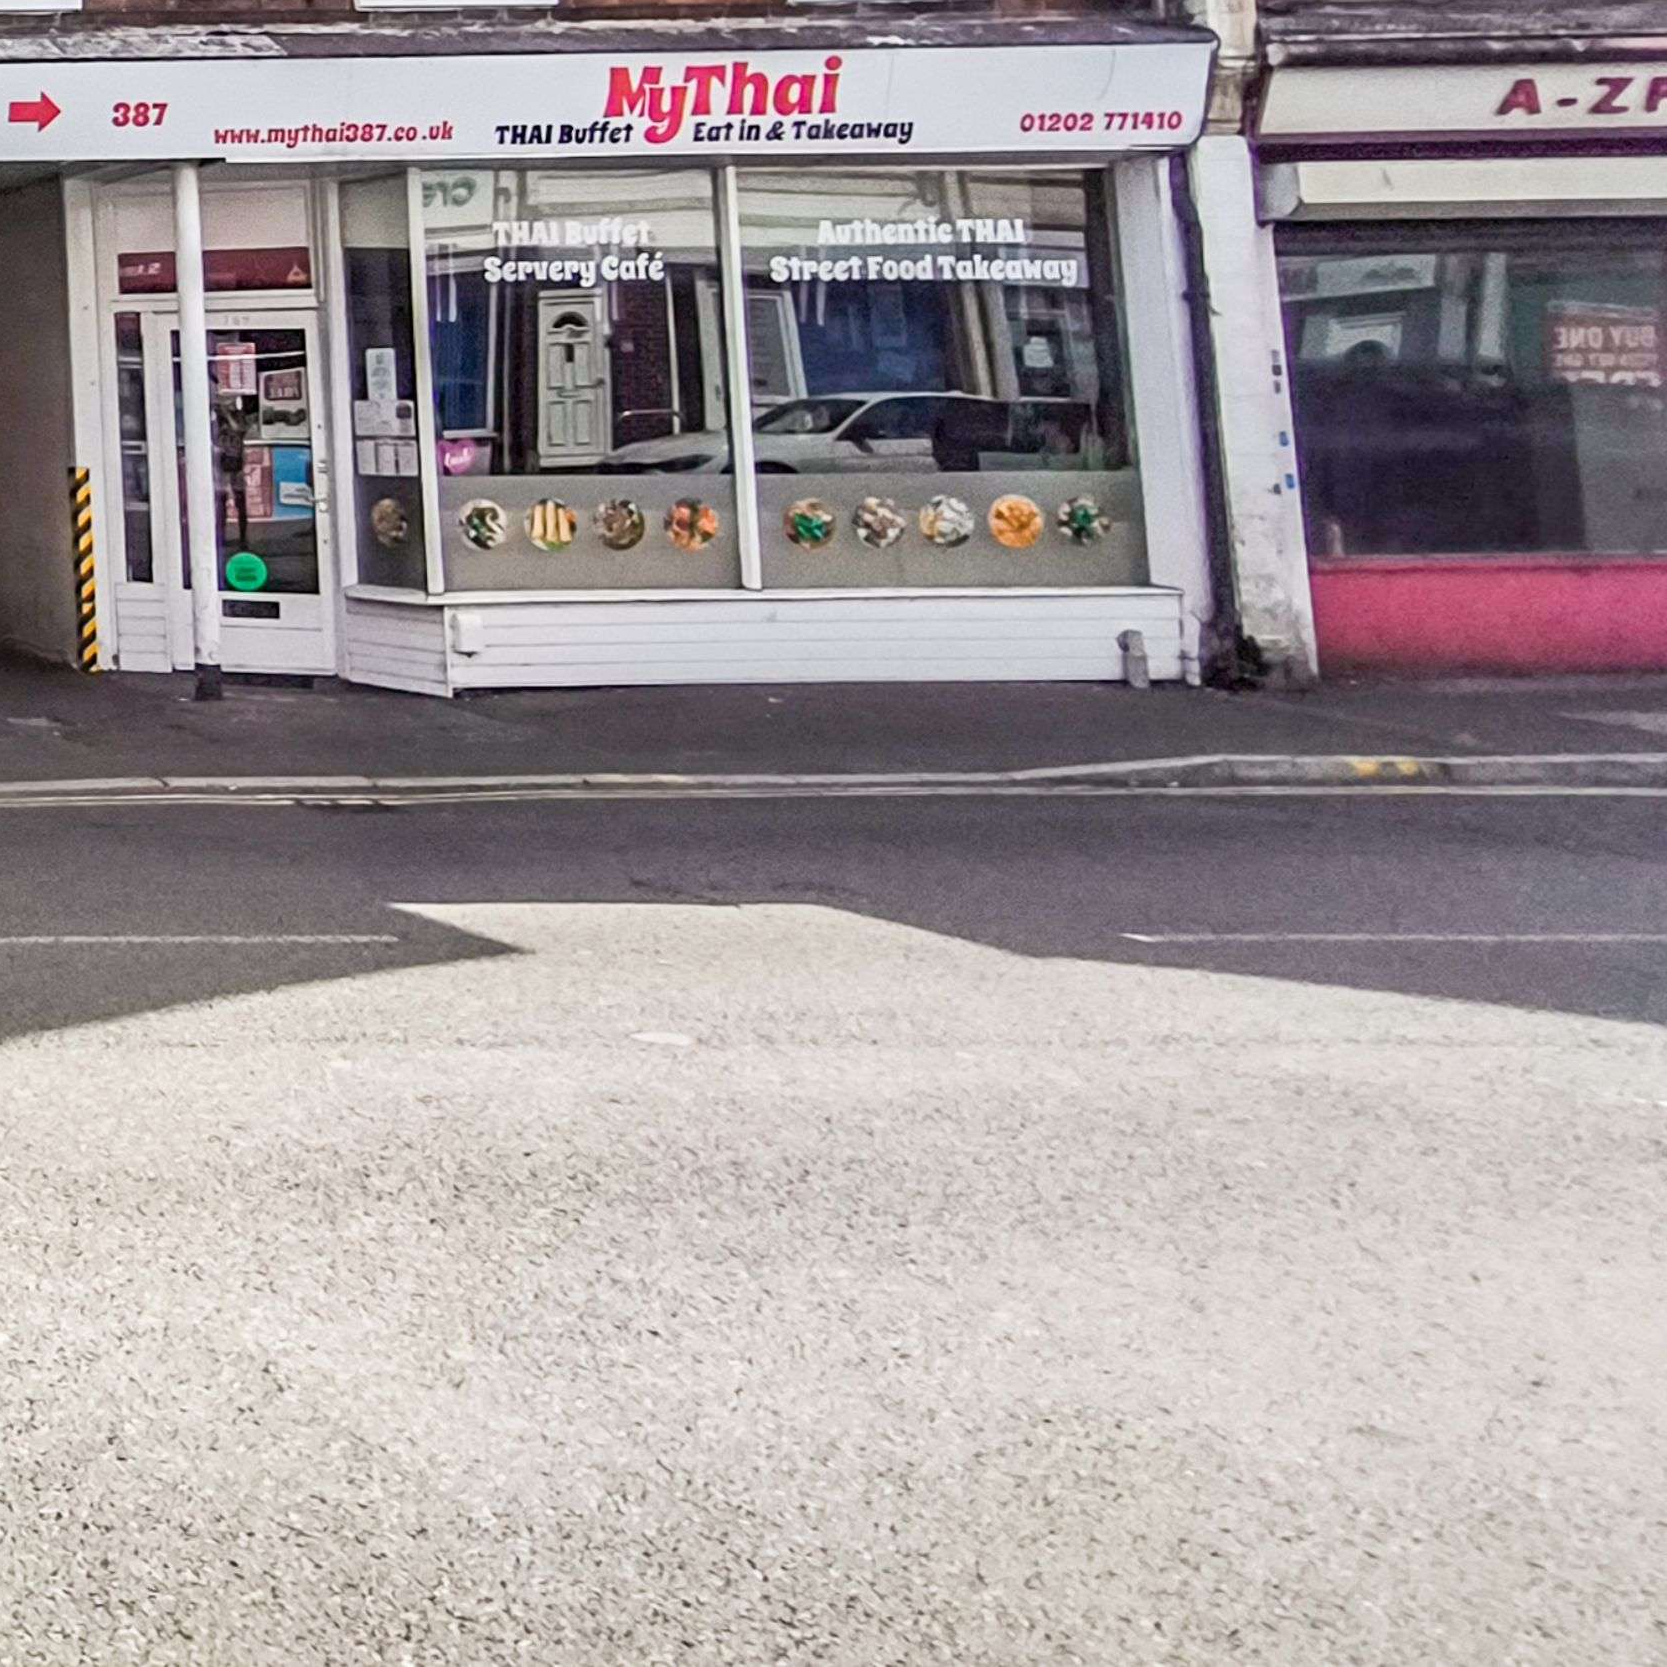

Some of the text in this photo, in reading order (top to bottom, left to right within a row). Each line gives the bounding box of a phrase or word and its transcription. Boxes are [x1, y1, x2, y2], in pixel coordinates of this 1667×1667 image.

[111, 102, 169, 127] 387
[603, 55, 843, 145] MyThai
[496, 118, 914, 145] THAI Buffet Eat in & Takeaway
[1020, 111, 1182, 133] 01202 771410
[492, 216, 652, 247] THAI Buffet
[817, 215, 1026, 245] Authentic THAI
[483, 252, 665, 288] Servery Café
[769, 254, 1078, 286] Street Food Takeaway
